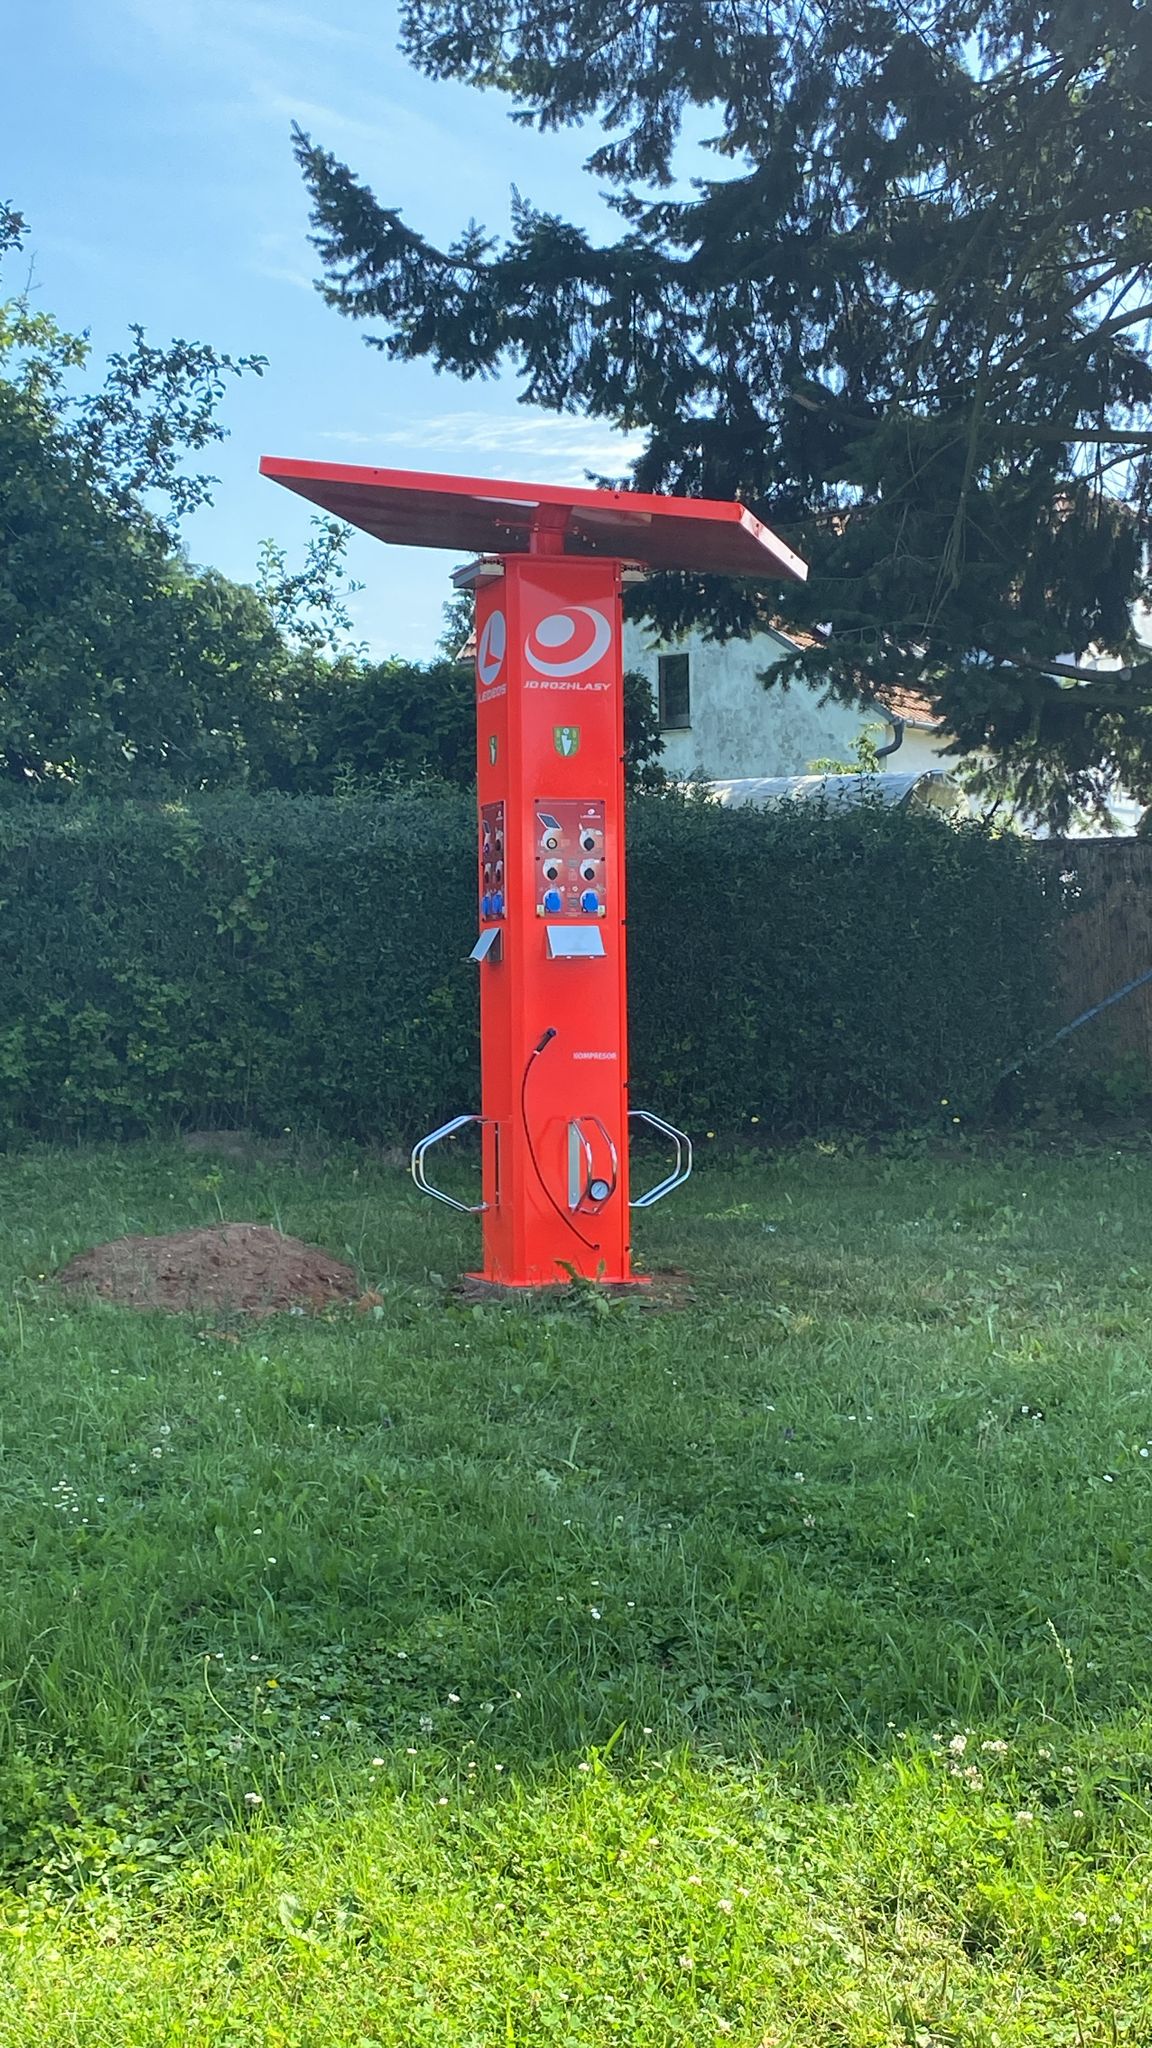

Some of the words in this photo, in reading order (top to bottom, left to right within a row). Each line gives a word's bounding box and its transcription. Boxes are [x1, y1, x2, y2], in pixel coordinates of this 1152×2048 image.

[523, 680, 539, 689] JD
[539, 681, 611, 691] ROZHLASY
[573, 1052, 617, 1061] KOMPRESOR
